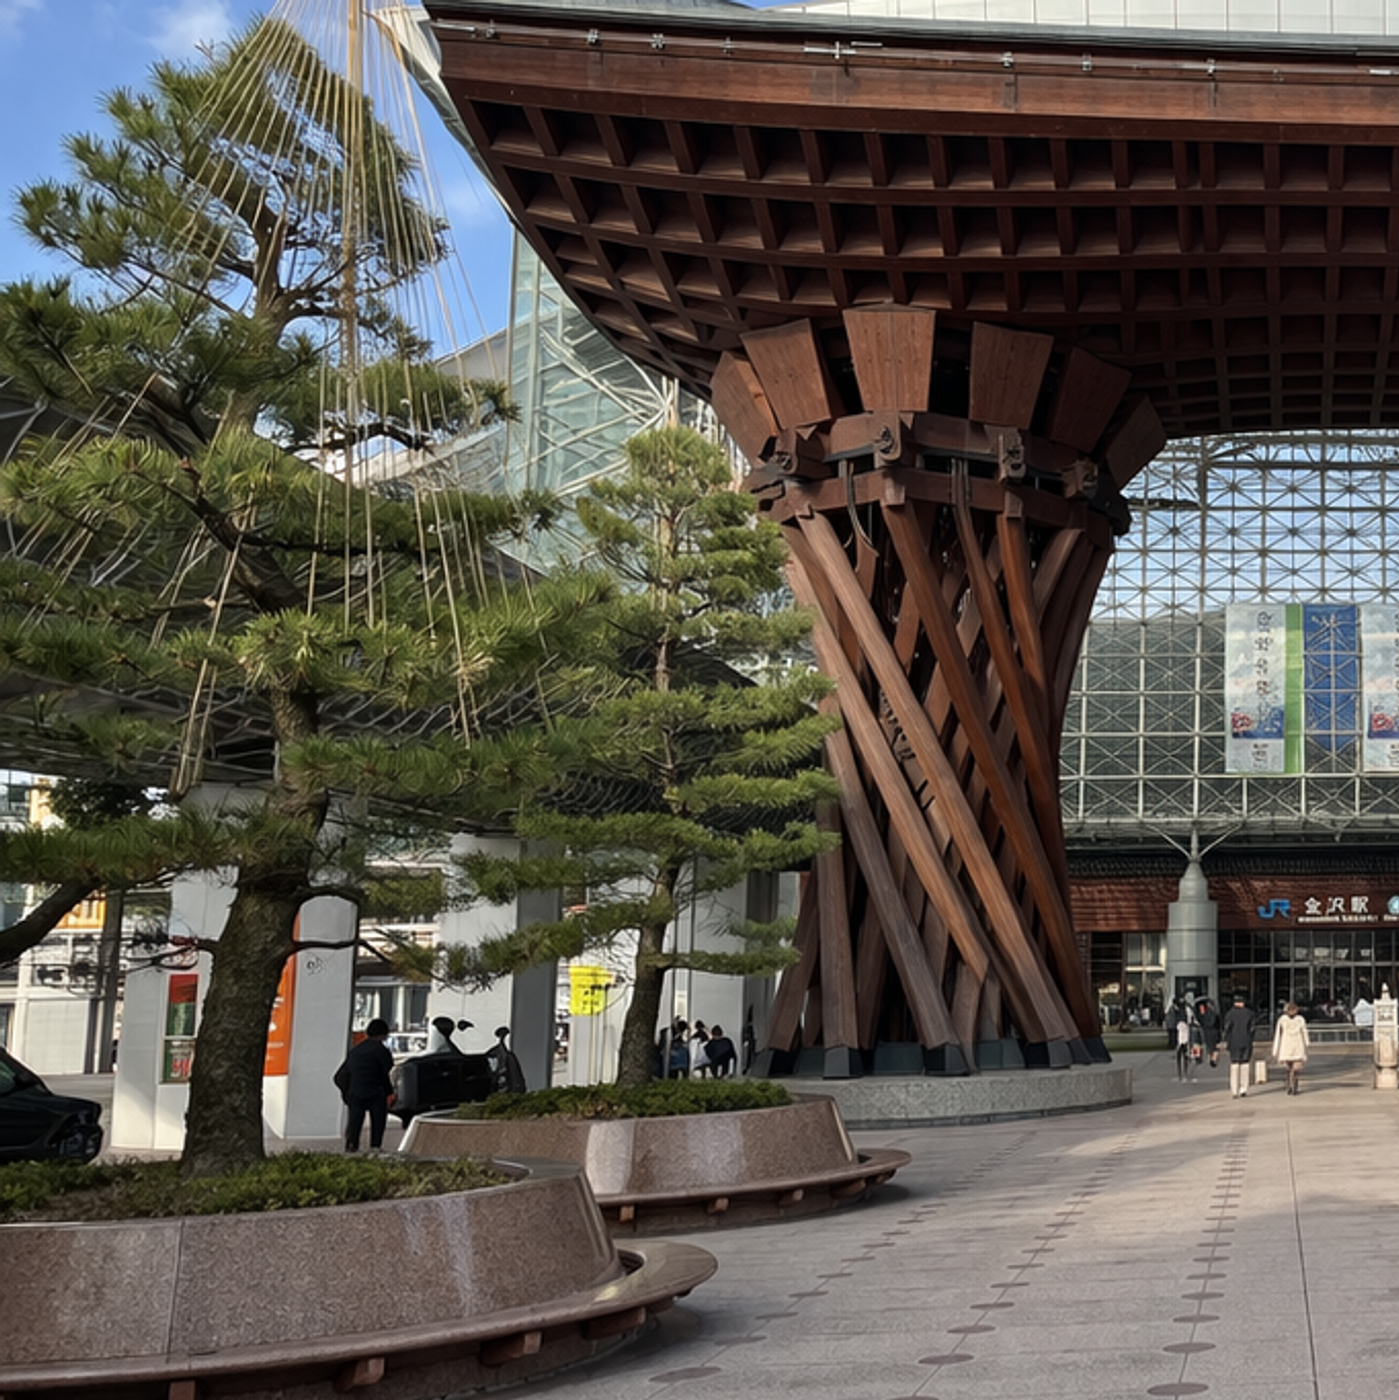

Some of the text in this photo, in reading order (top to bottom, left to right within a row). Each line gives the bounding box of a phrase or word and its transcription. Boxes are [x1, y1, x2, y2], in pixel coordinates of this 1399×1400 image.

[1257, 896, 1369, 919] JR 金沢駅
